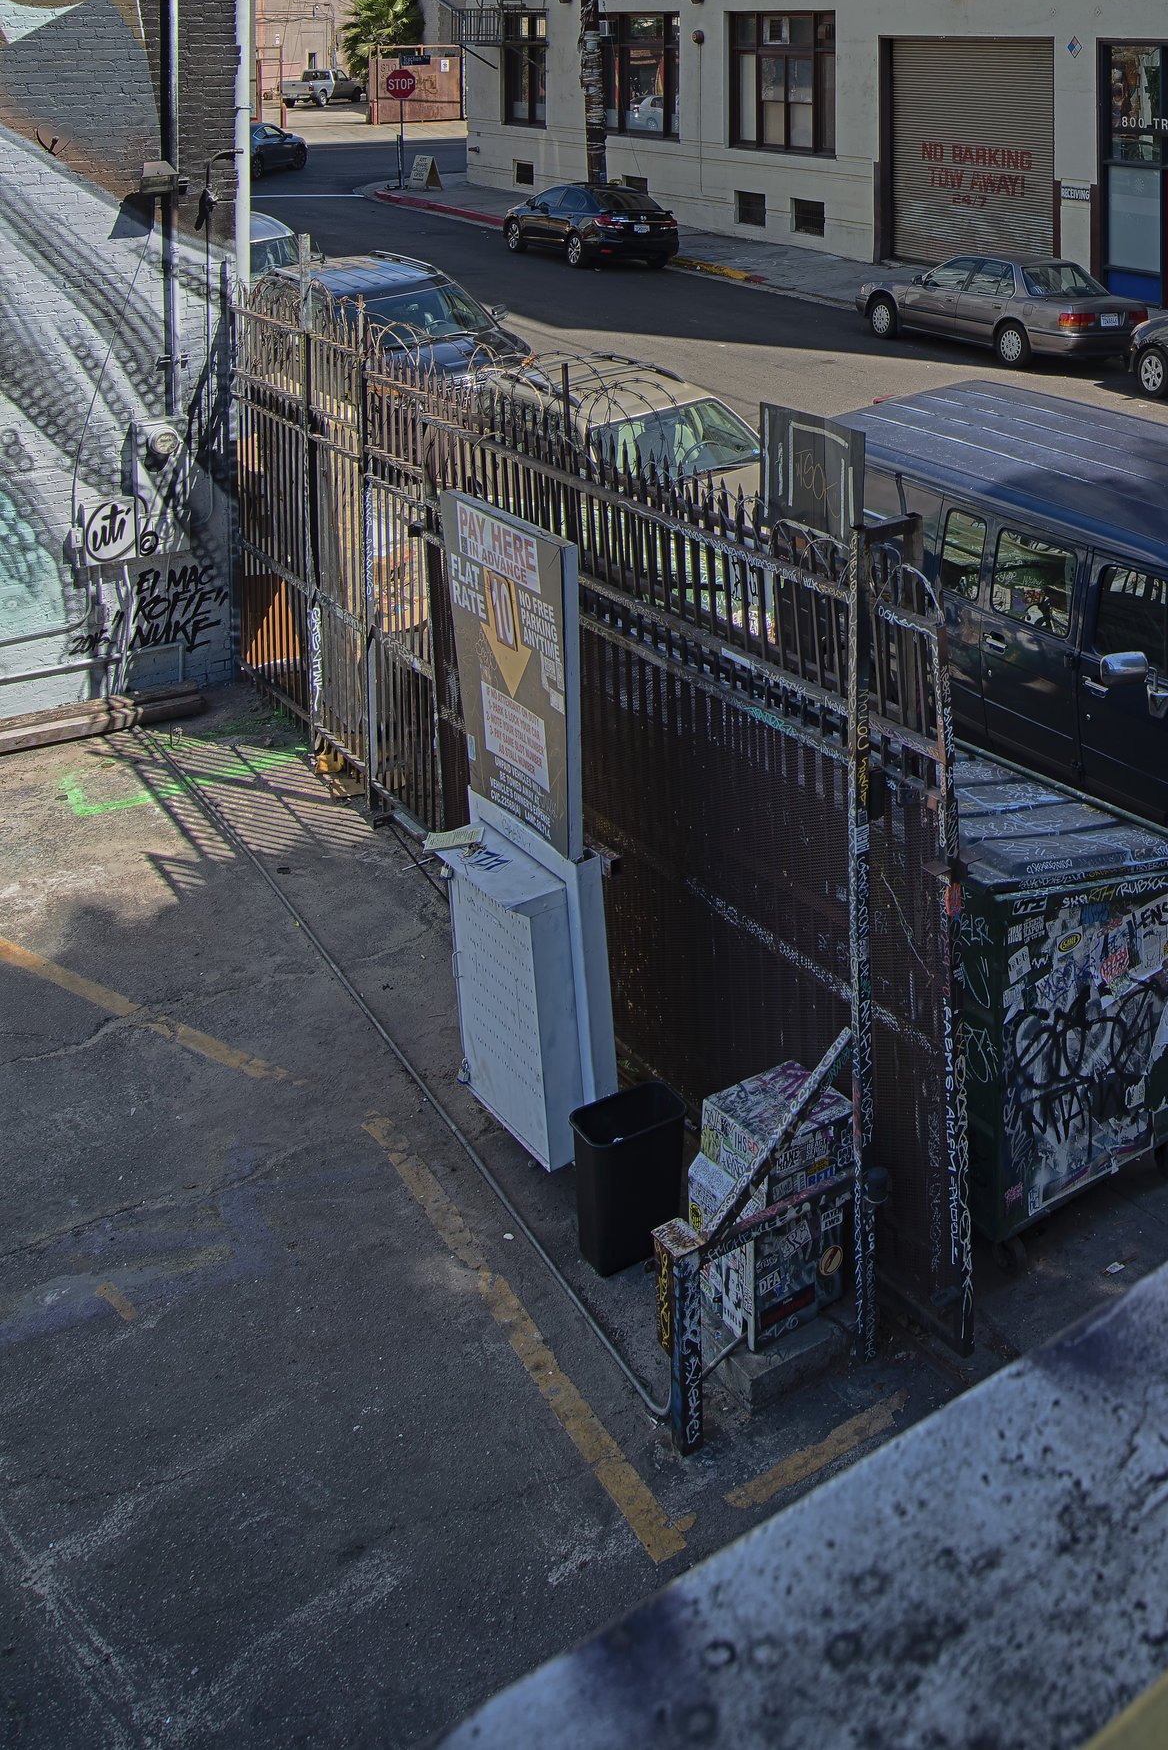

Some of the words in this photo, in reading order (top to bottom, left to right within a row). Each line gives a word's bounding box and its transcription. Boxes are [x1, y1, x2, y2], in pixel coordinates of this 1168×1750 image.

[388, 78, 414, 90] STOP
[1121, 116, 1146, 129] 800
[922, 142, 944, 162] NO
[927, 166, 965, 190] TOW
[1061, 186, 1091, 201] RECEIVING
[459, 506, 486, 546] PAY
[490, 521, 537, 573] HERE
[167, 564, 214, 594] MAC
[450, 552, 480, 591] FLAT
[468, 537, 479, 558] IN
[481, 548, 528, 585] ADVANCE
[452, 579, 487, 620] RATE
[491, 578, 514, 645] 10
[518, 589, 531, 611] NO
[532, 596, 555, 624] FREE
[129, 616, 222, 653] NUKE
[520, 607, 558, 643] PARKING
[523, 627, 561, 663] ANYTIME
